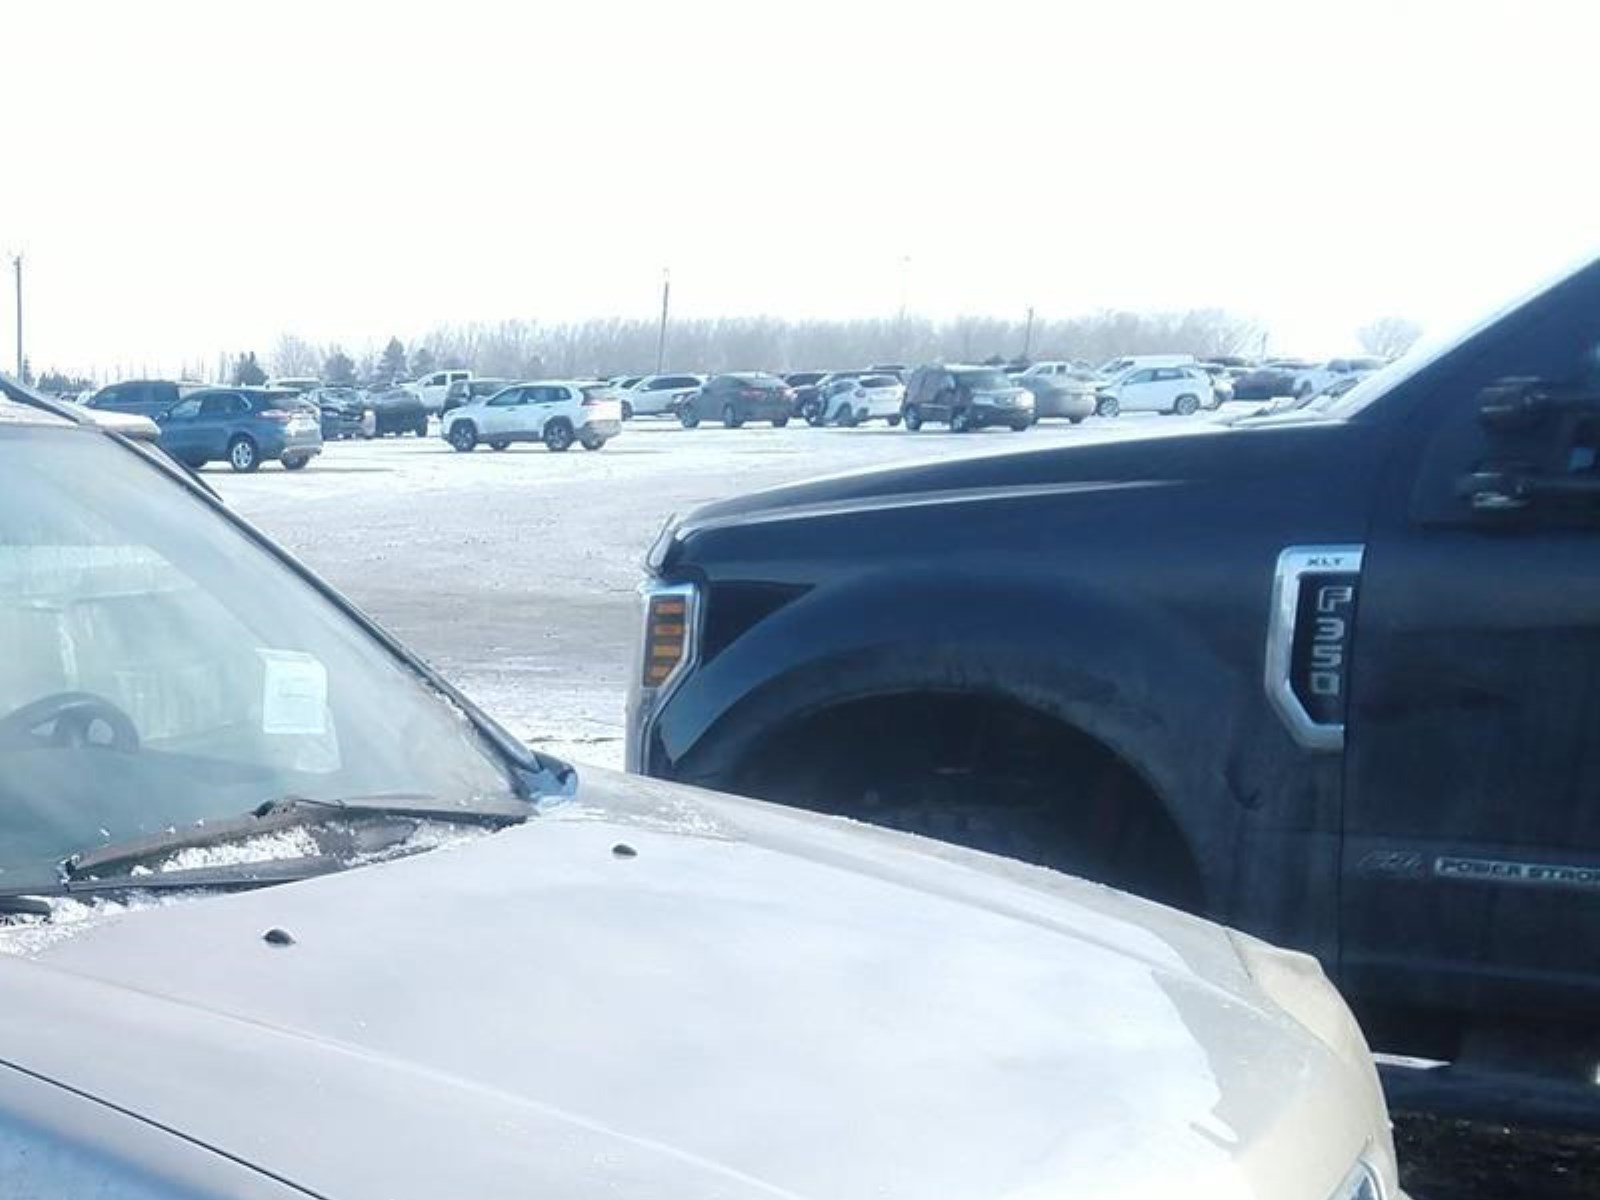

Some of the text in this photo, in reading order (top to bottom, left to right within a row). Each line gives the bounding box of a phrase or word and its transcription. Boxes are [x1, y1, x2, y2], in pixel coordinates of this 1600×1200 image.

[1307, 557, 1345, 567] XLT
[1311, 585, 1353, 696] F350
[1440, 860, 1520, 880] POWER
[1527, 865, 1600, 883] STRO
